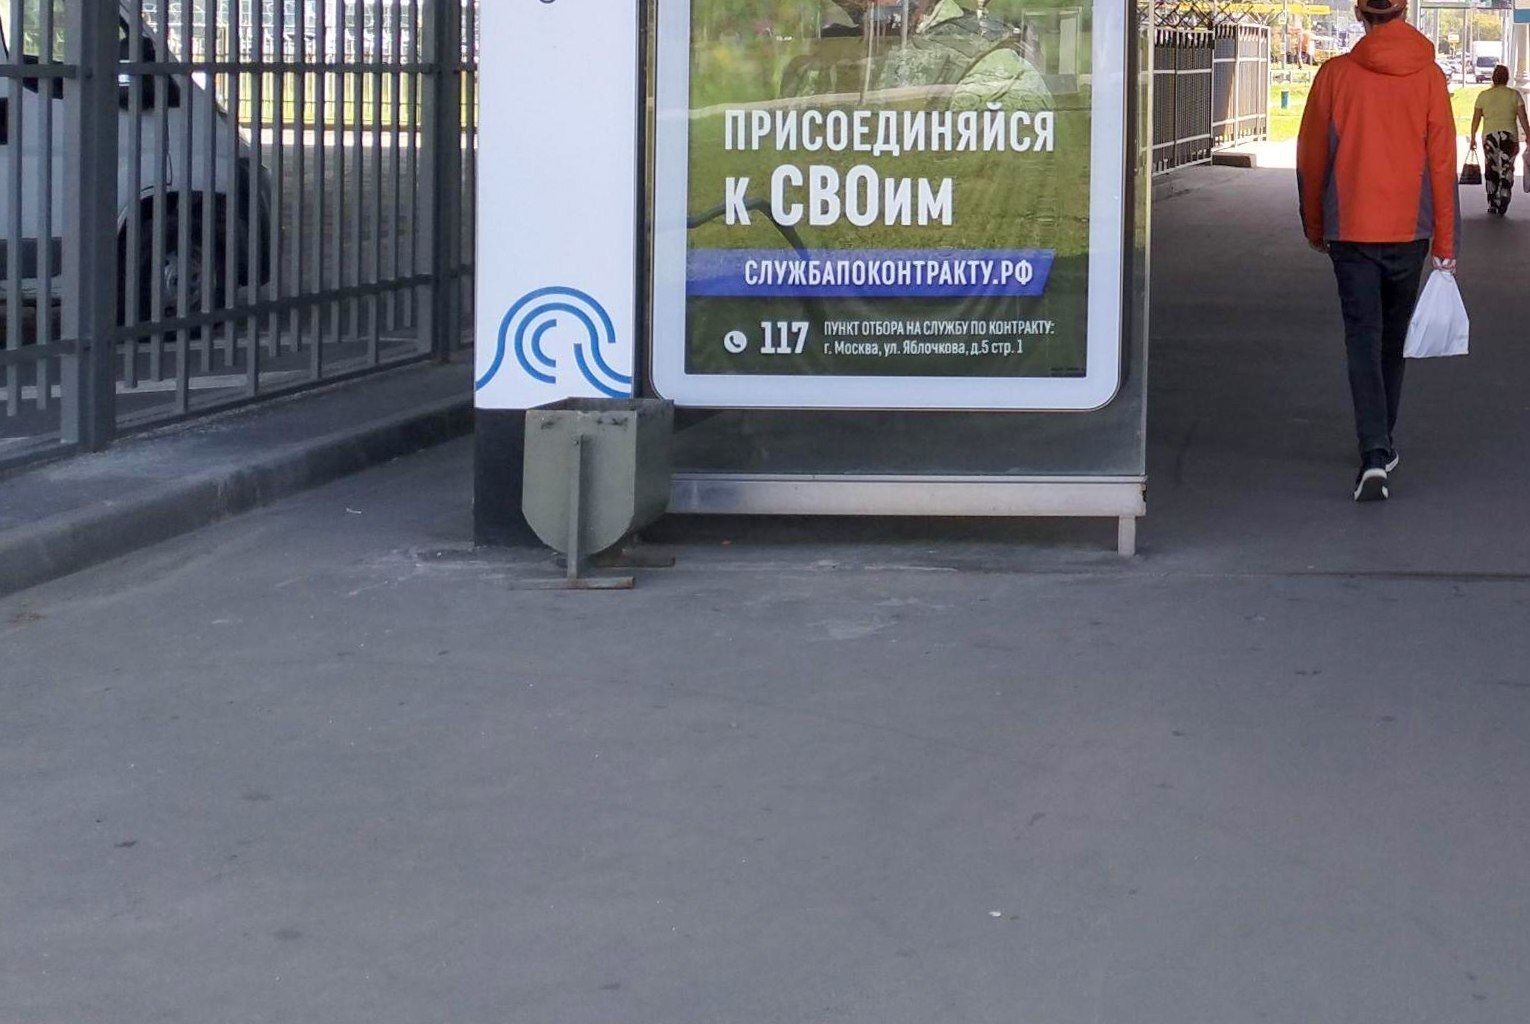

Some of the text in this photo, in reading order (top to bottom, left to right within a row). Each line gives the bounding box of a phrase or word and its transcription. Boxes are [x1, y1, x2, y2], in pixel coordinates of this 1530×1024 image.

[724, 102, 1055, 157] ПРИСОЕДИНЯЙСЯ
[745, 260, 1033, 286] СЛУЖБАПОКОНТРАКТУ.РФ
[760, 321, 810, 354] 117
[824, 320, 1055, 335] ПУНКТ ОТБОРА НА СЛУЖБУ ПО КОНТРАКТУ:
[824, 342, 832, 354] г.
[834, 340, 882, 356] Москва,
[884, 342, 900, 357] ул.
[903, 340, 969, 355] Яблочкова,
[991, 342, 1015, 356] стр.
[1017, 339, 1024, 353] 1
